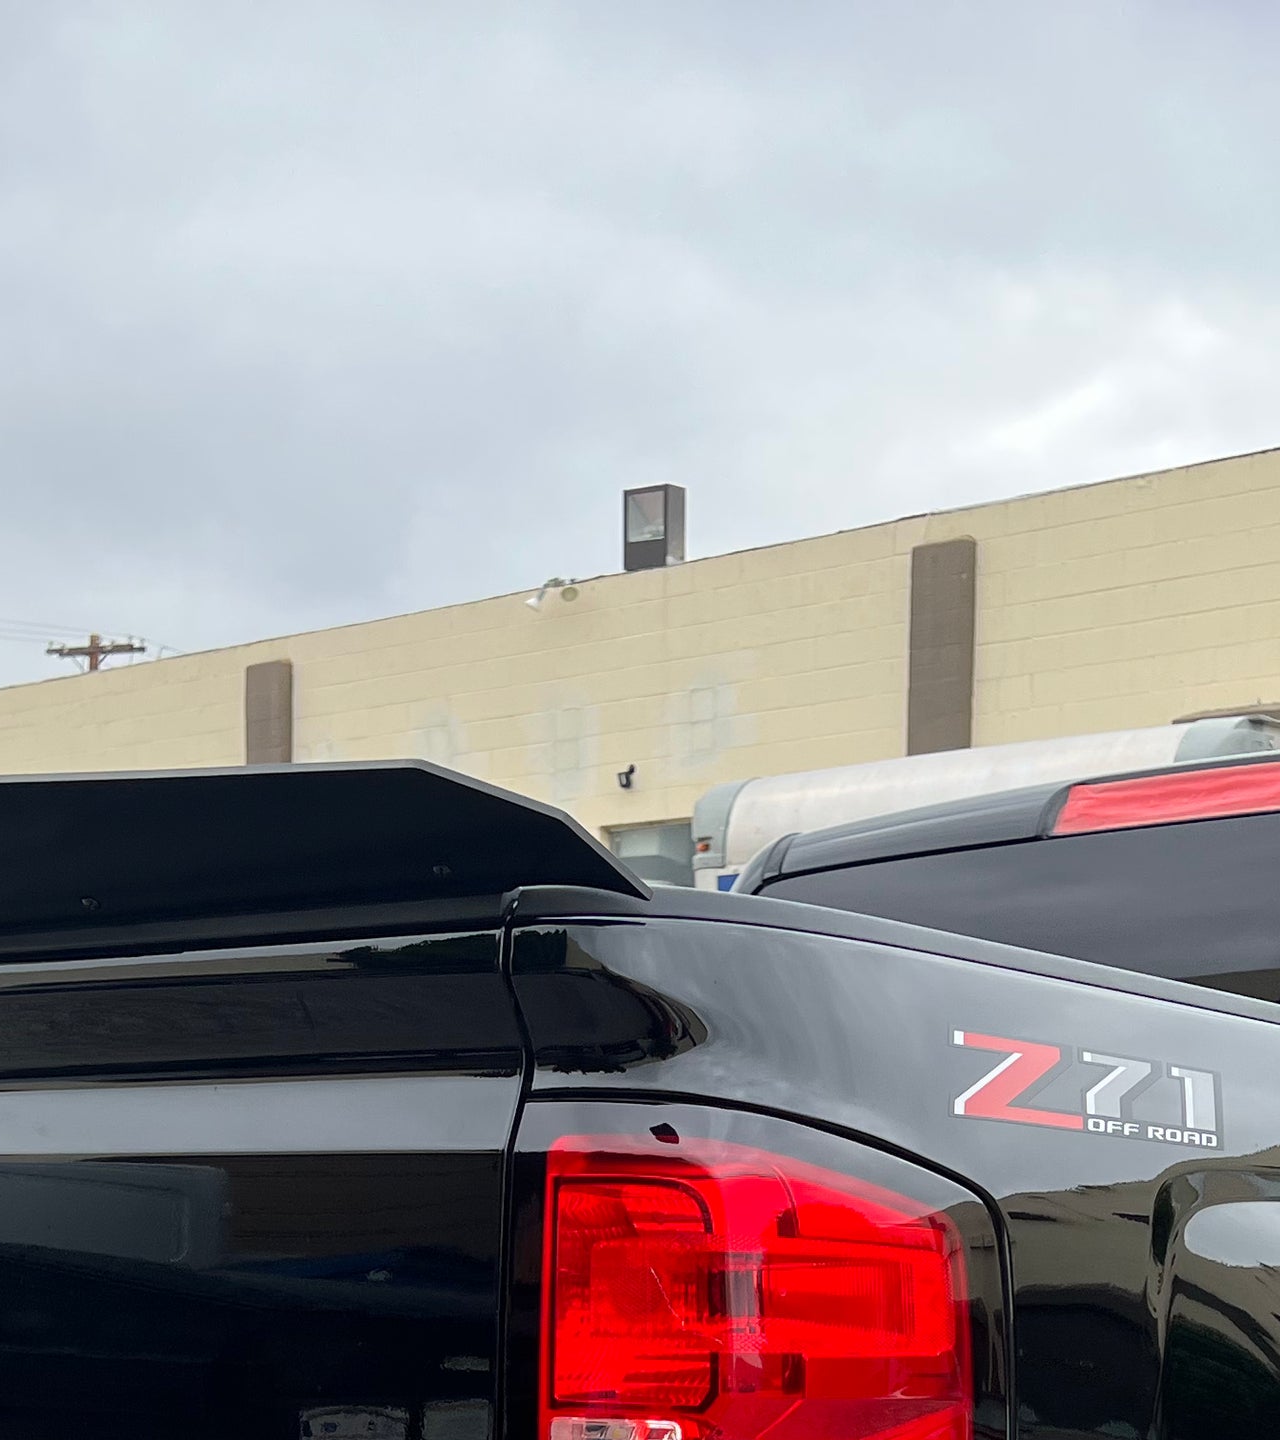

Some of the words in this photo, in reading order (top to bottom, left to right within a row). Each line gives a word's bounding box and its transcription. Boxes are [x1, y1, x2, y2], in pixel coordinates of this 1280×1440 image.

[952, 1030, 1217, 1132] Z71
[1087, 1118, 1140, 1136] OFF
[1147, 1126, 1218, 1147] ROAD
